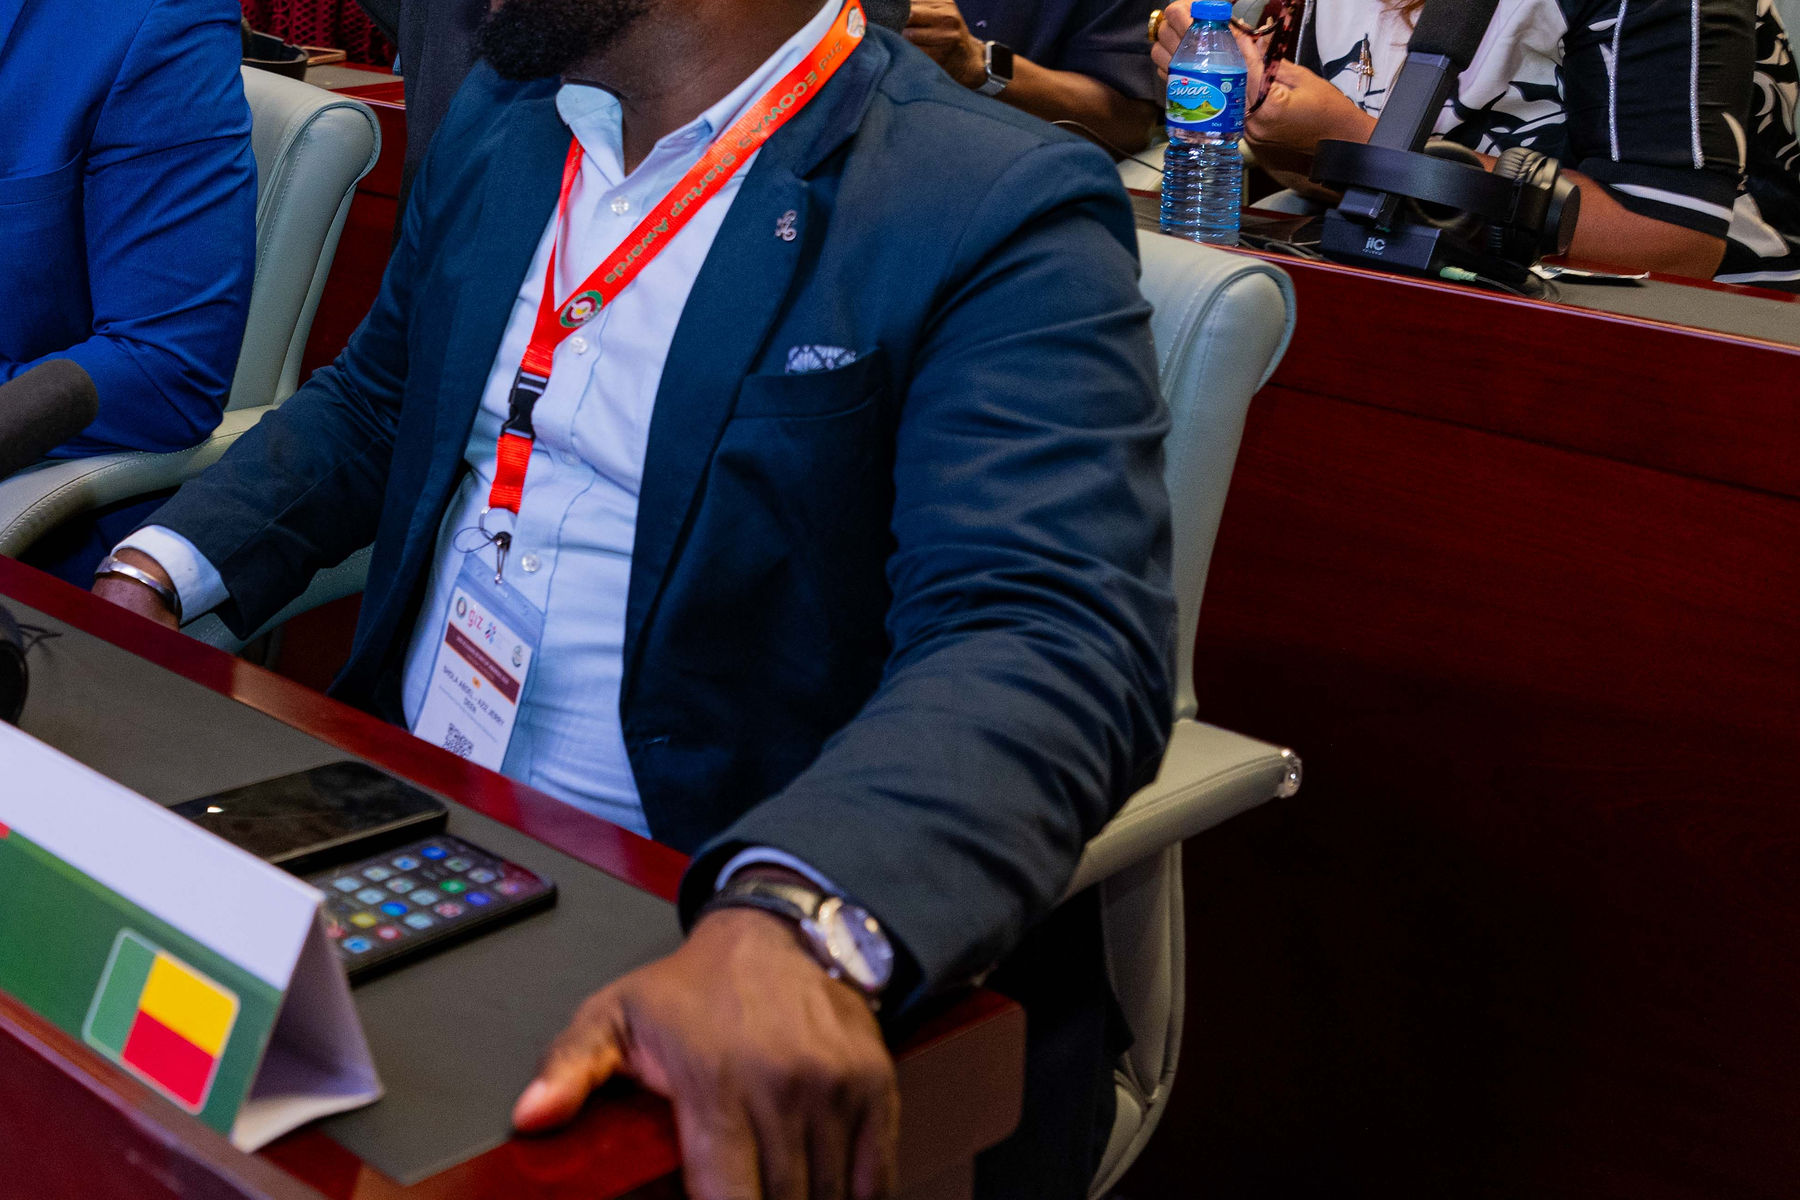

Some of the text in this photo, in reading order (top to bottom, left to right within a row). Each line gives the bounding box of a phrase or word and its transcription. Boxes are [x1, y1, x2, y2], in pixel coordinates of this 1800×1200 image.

[1168, 80, 1210, 96] Swan
[604, 41, 843, 284] 2nd ECOWAS Startup Awards
[467, 609, 484, 630] giz
